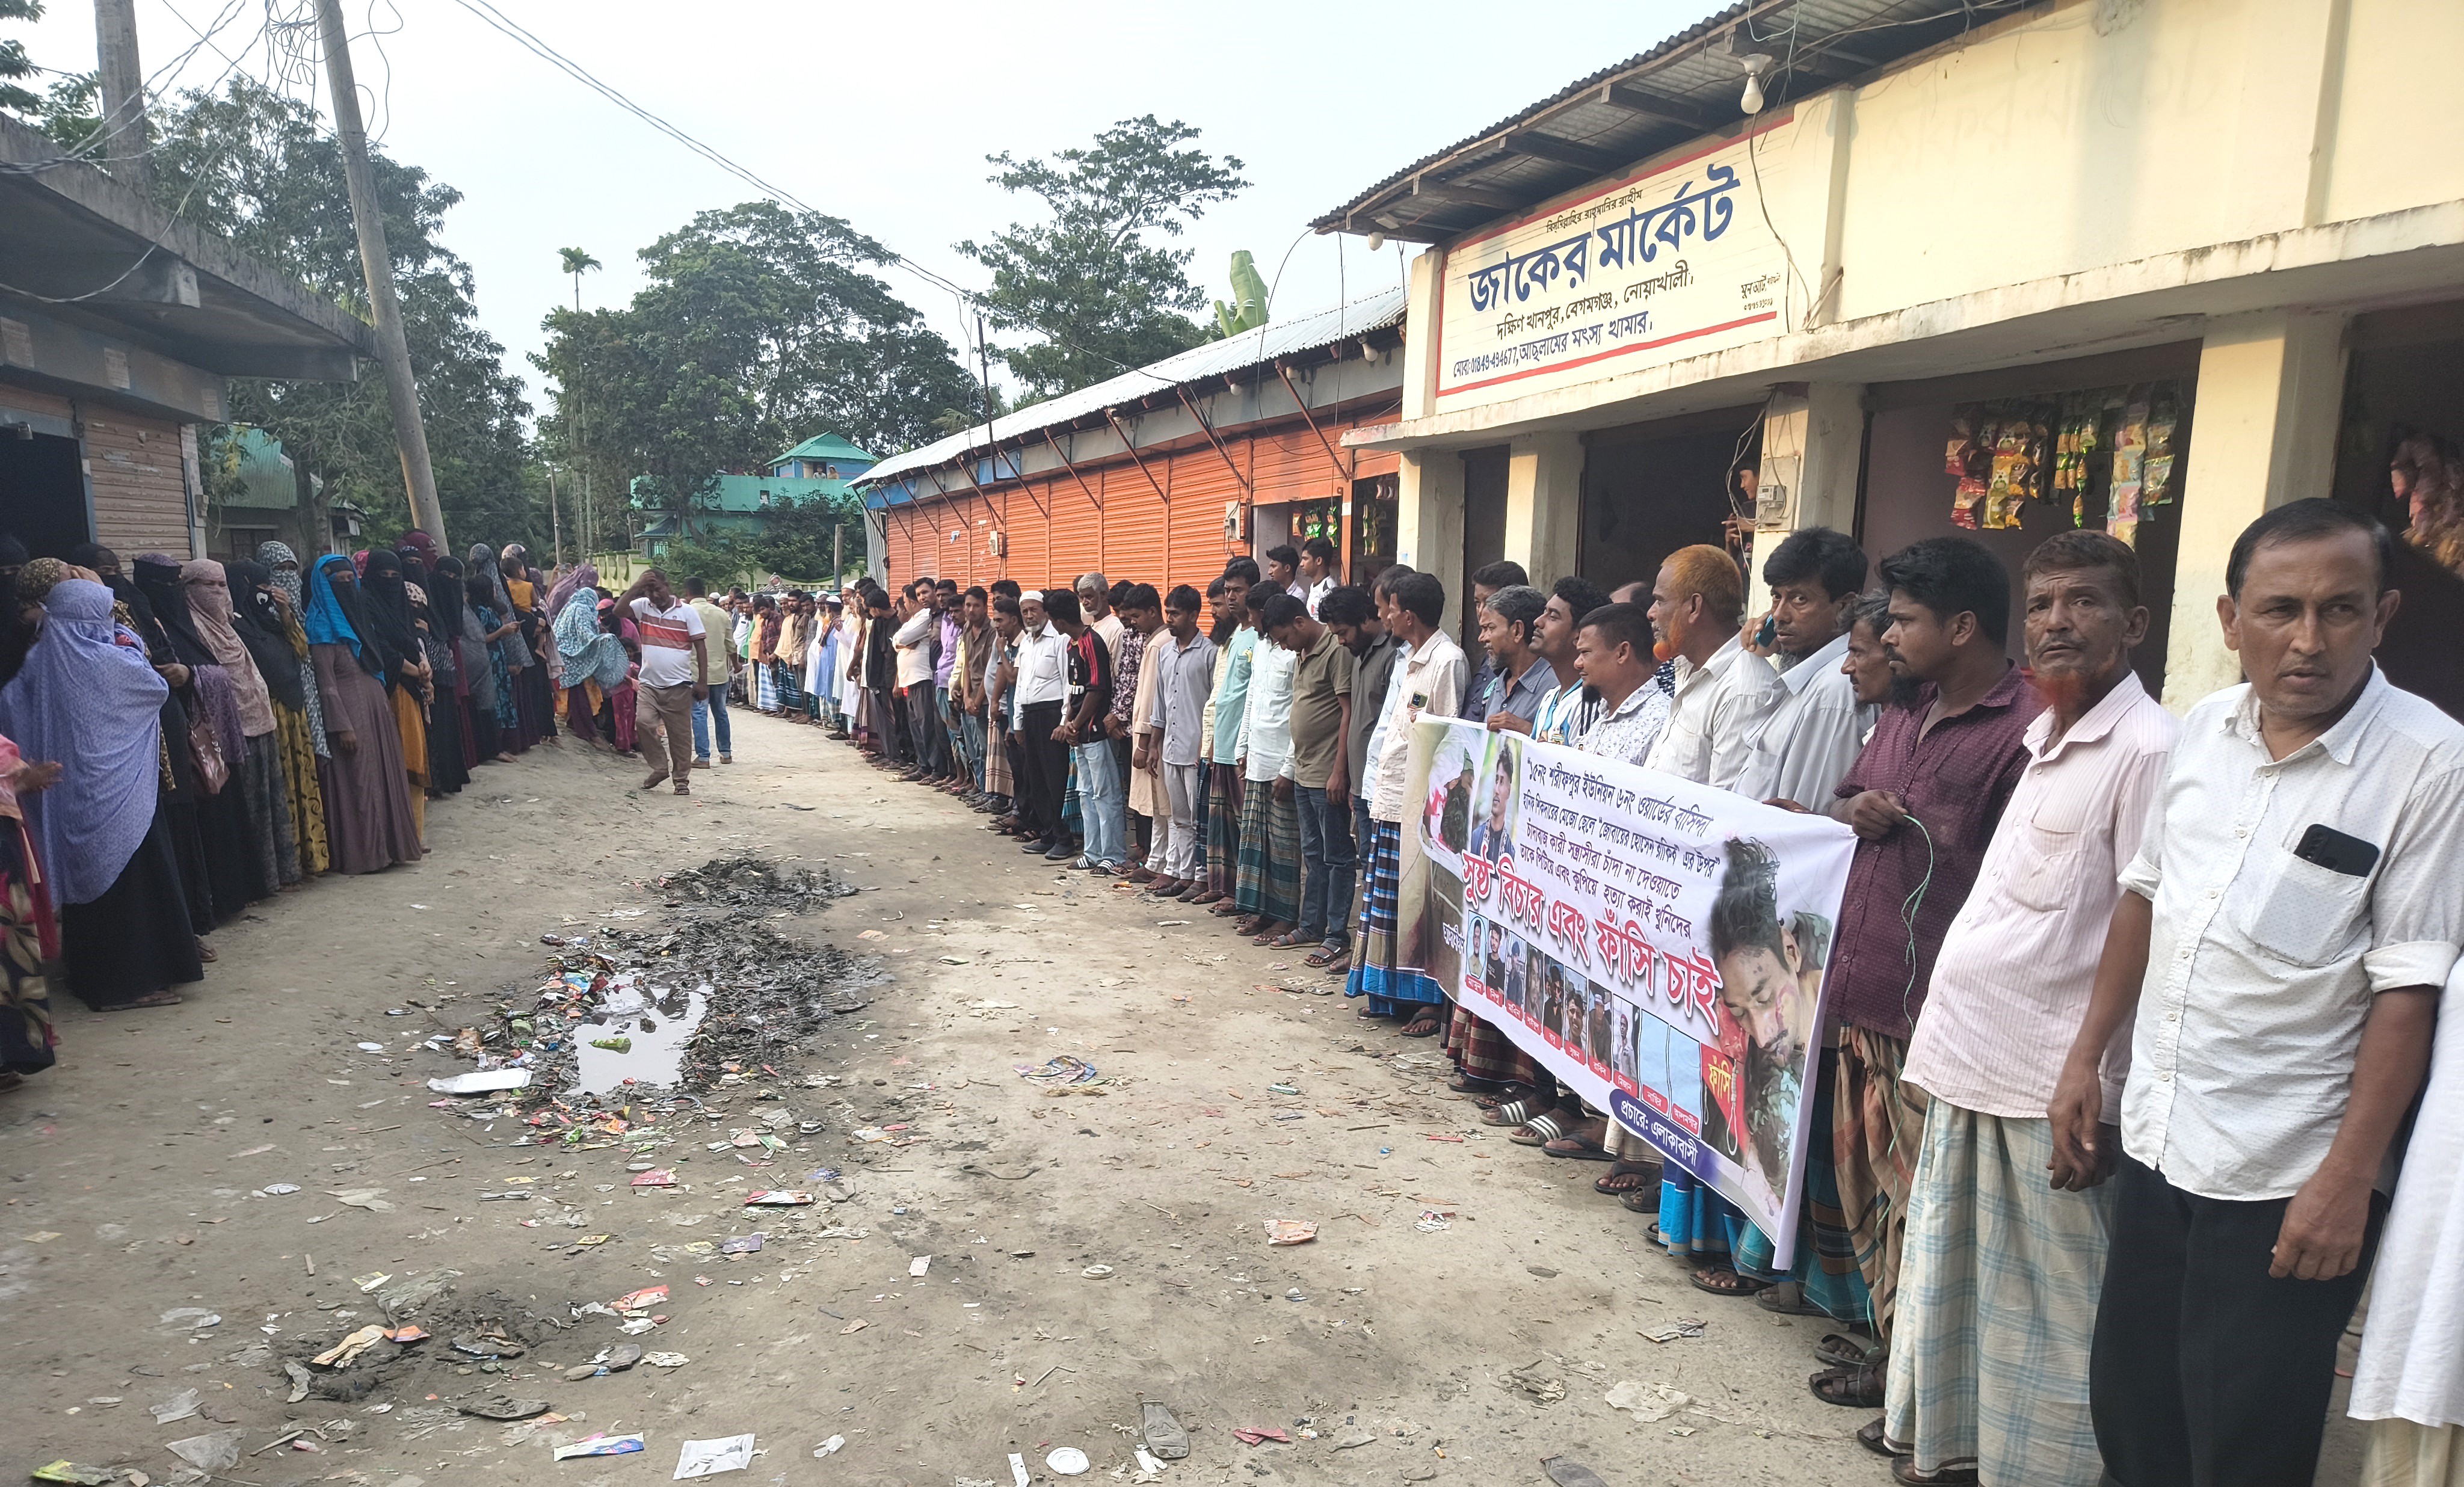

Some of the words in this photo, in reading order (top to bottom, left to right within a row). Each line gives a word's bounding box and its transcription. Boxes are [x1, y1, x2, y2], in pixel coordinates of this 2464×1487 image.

[1468, 231, 1592, 312] জাকের
[1596, 164, 1740, 270] মার্কেট
[1496, 312, 1525, 340] দক্ষিণ
[1550, 762, 1581, 799] শরীফপুর
[1582, 771, 1616, 806] ইউনিয়ন
[1638, 795, 1676, 825] ওয়ার্ডের
[1675, 804, 1714, 837] বাসিন্দা
[1550, 831, 1567, 855] কারী
[1603, 849, 1624, 877] চাঁদা
[1625, 863, 1636, 883] না
[1637, 867, 1682, 899] দেওয়াতে
[1578, 814, 1597, 835] ছেলে
[1630, 833, 1654, 858] হোসেন
[1683, 851, 1695, 872] এর
[1520, 843, 1535, 864] তাকে
[1555, 864, 1570, 886] এবং
[1572, 868, 1598, 897] কুপিয়ে
[1603, 884, 1625, 909] হত্যা
[1628, 896, 1653, 923] করাই
[1656, 904, 1692, 940] খুনিদের
[1497, 856, 1544, 932] বিচার
[1548, 900, 1589, 964] এবং
[1594, 907, 1657, 994] ফাঁসি
[1662, 946, 1722, 1032] চাই
[1708, 1054, 1732, 1103] ফাঁসি
[1651, 1121, 1698, 1167] এলাকাবাসী
